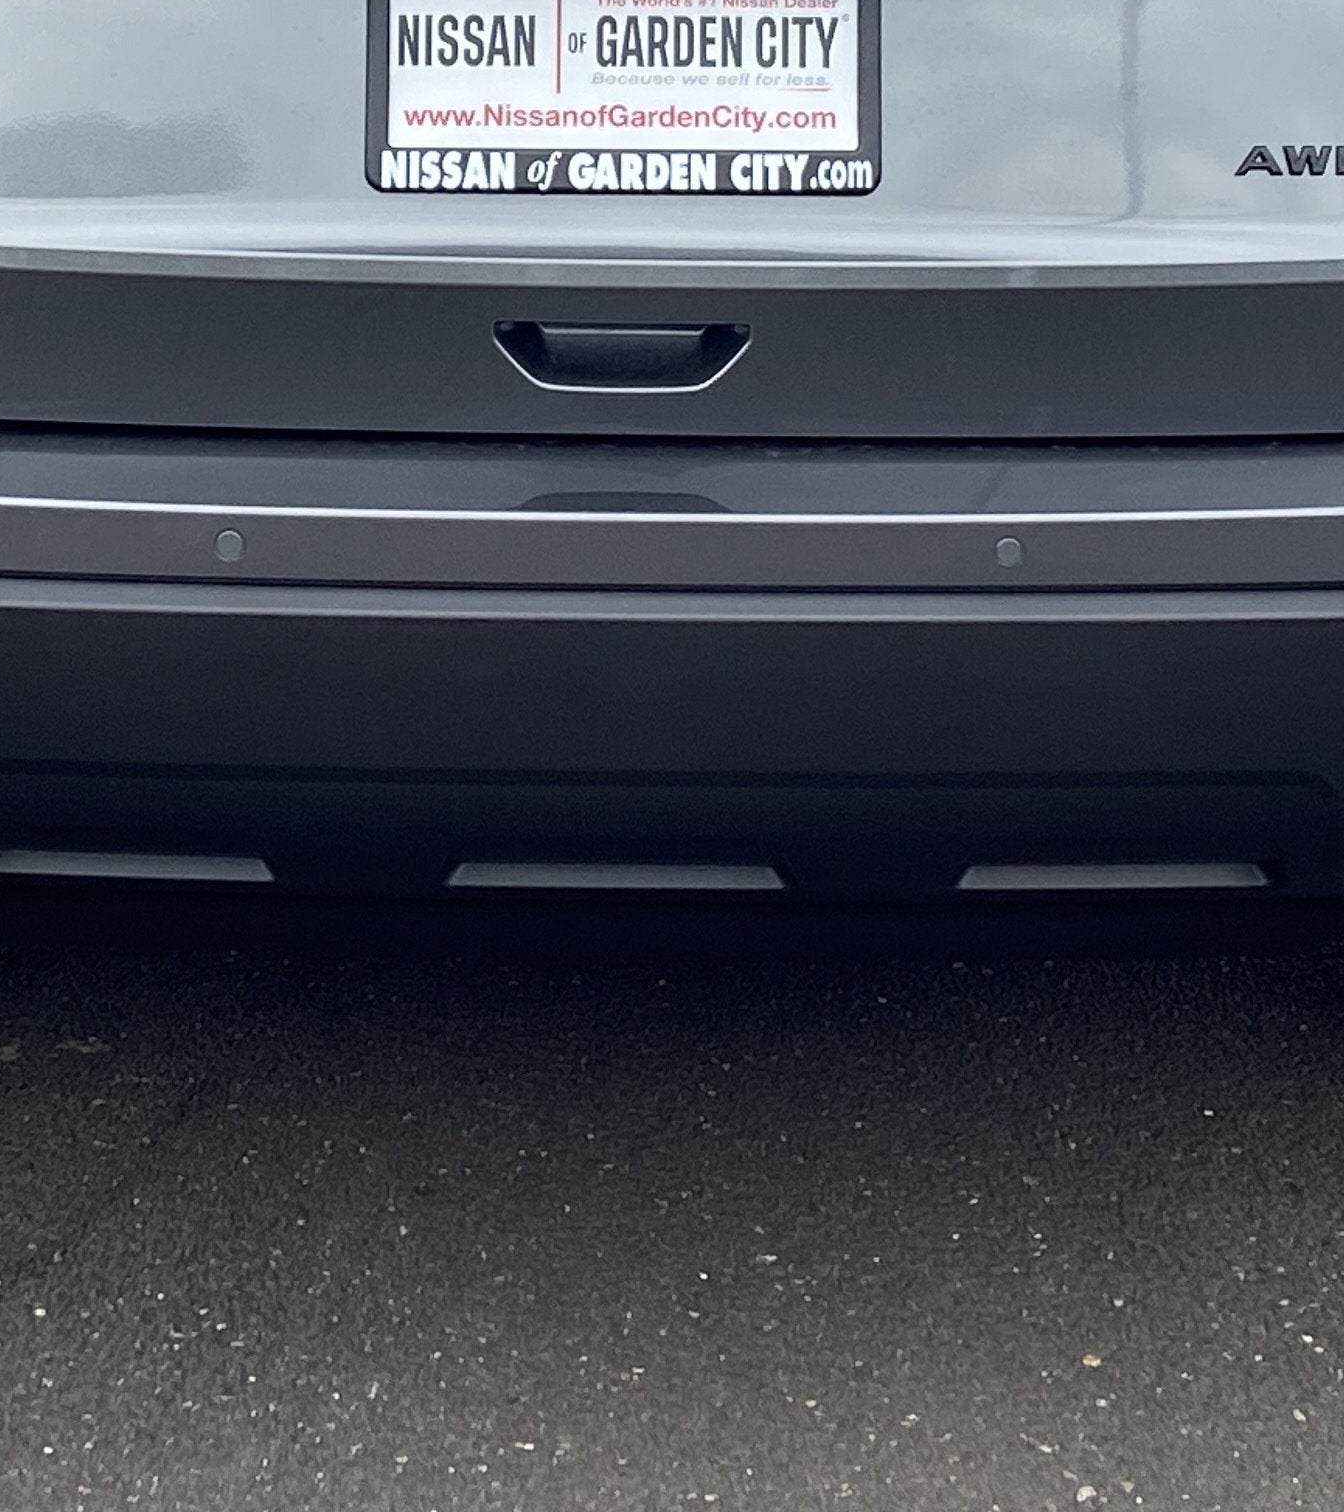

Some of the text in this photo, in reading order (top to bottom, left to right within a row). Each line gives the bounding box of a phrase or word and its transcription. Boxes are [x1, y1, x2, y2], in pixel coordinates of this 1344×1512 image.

[397, 14, 839, 68] NISSAN OF GARDEN CITY
[591, 71, 831, 87] Because we sell for less.
[403, 104, 837, 133] www.NissanofGardenCity.com
[380, 149, 874, 191] NISSAN of GARDEN CITY.com
